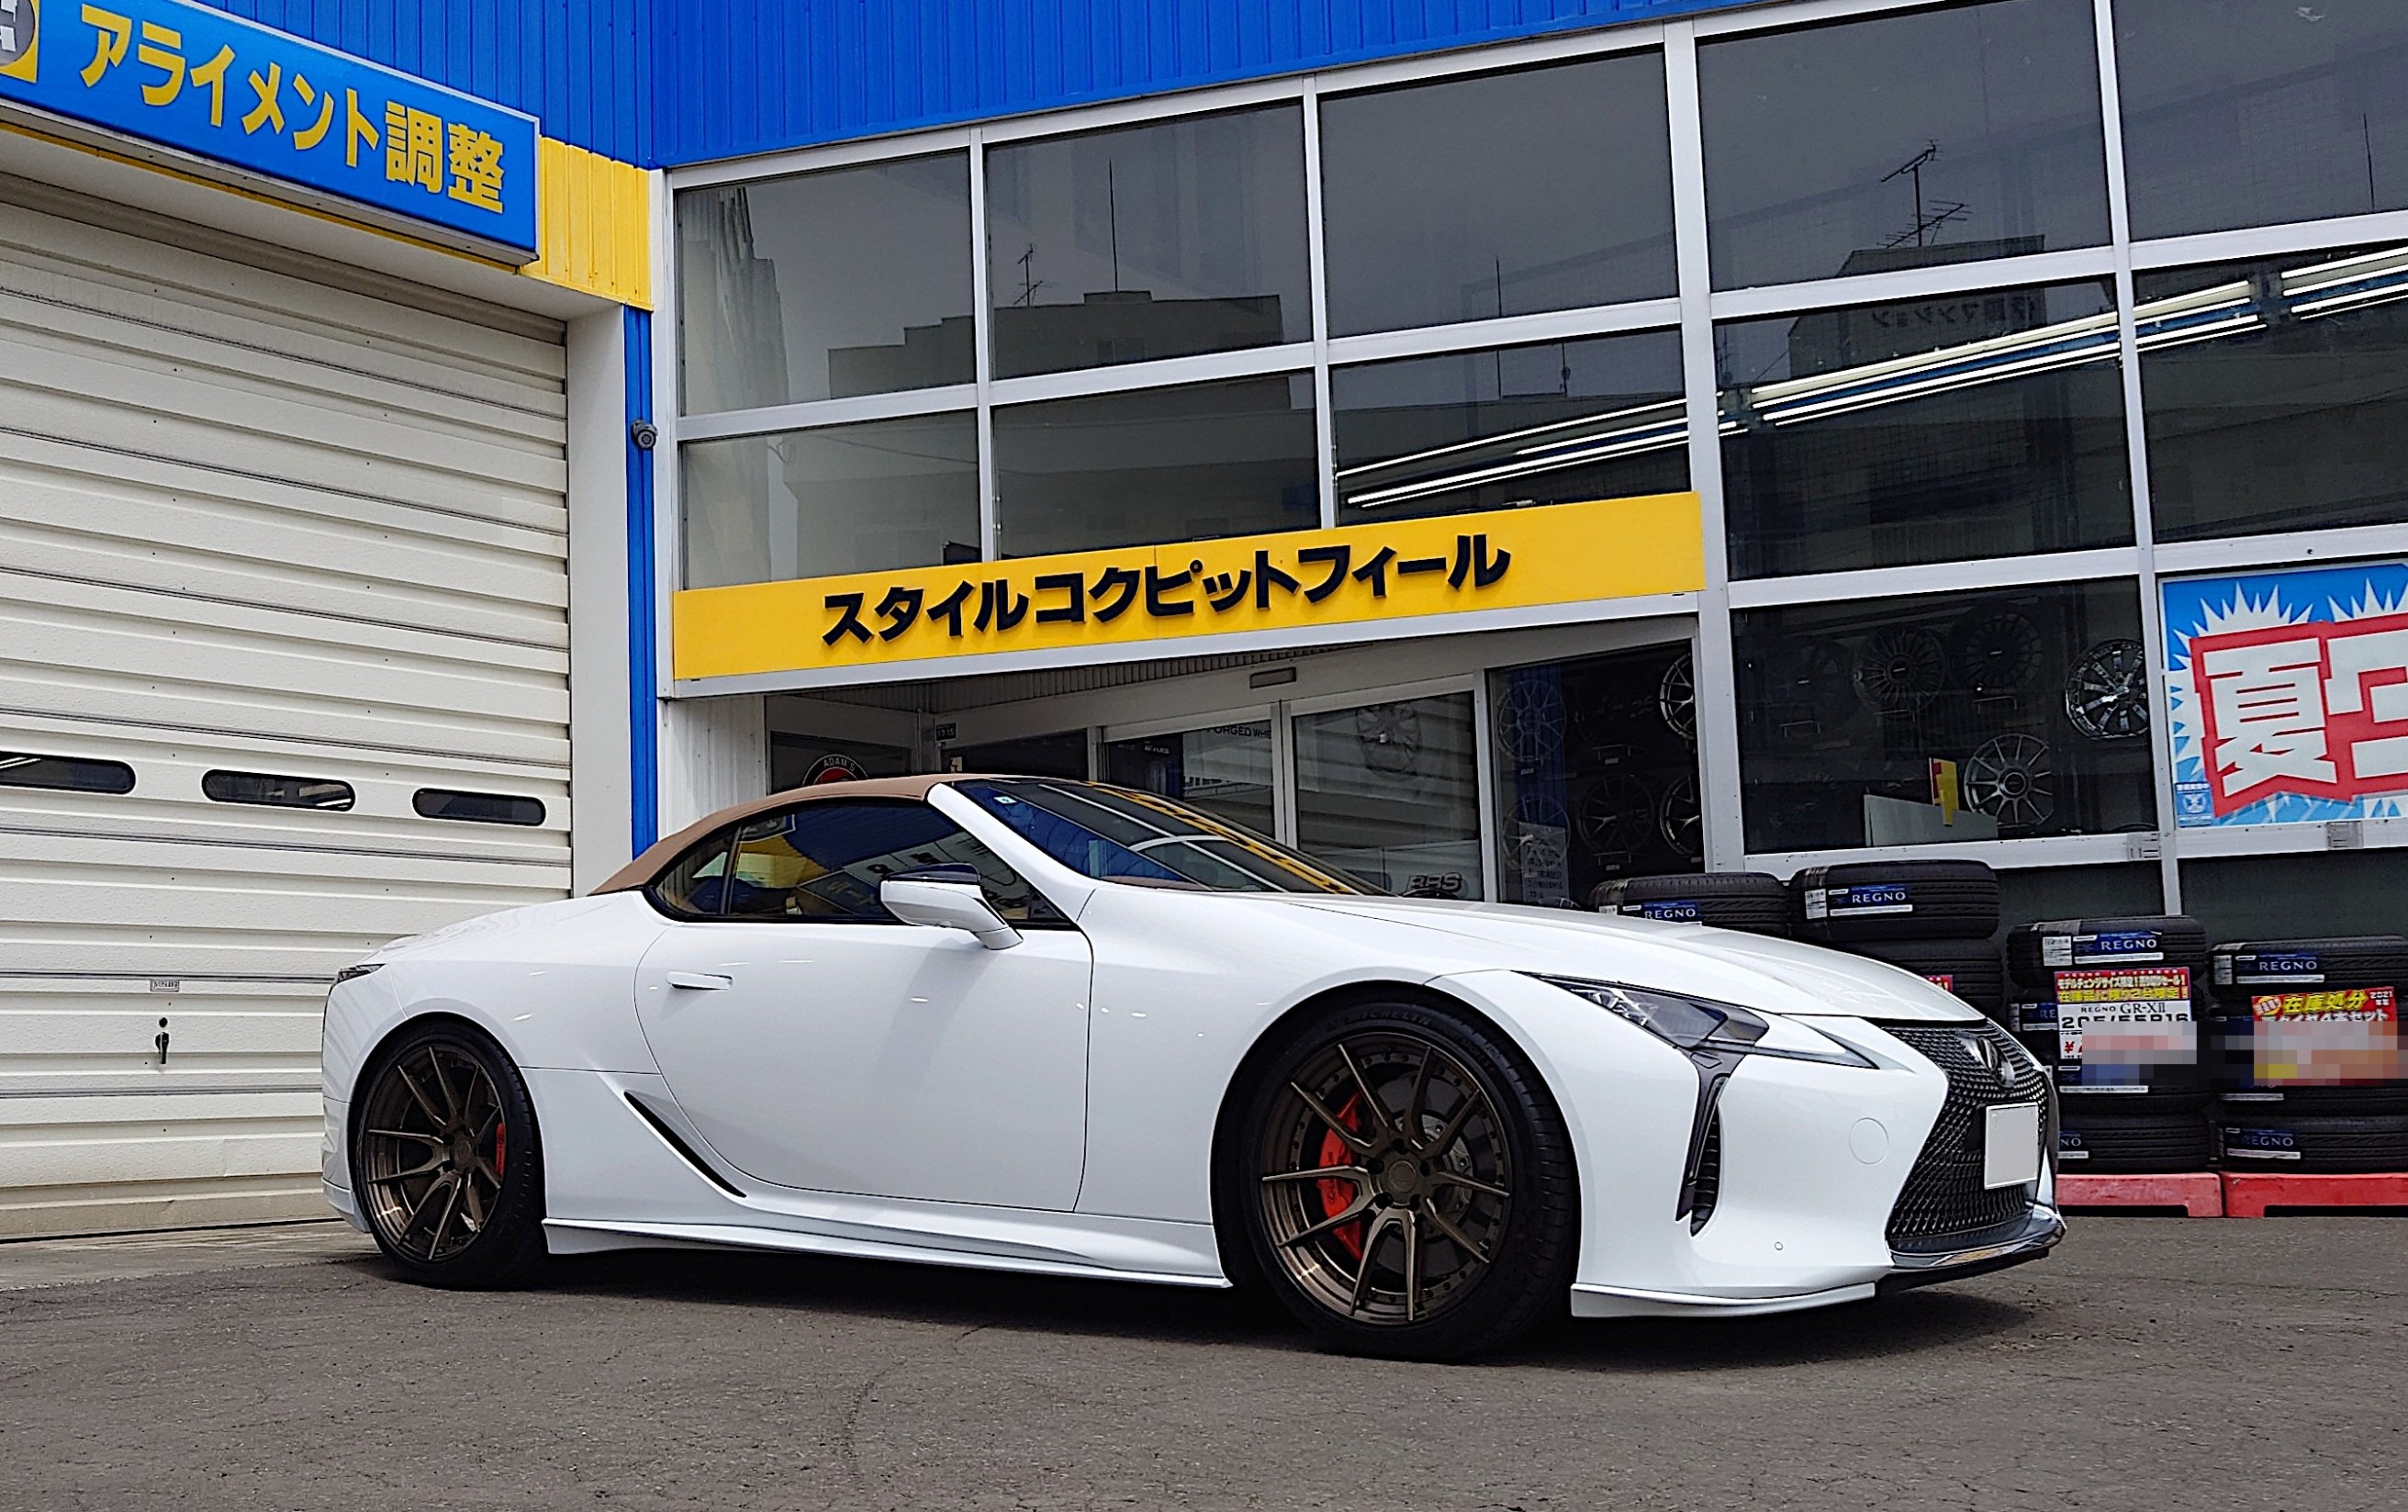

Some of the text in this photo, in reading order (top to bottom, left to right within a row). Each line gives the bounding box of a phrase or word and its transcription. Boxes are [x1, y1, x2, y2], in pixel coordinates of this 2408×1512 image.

[80, 3, 504, 214] アライメント調整
[822, 533, 1512, 646] スタイルコクピットフィール
[1206, 725, 1252, 736] ORGED
[1852, 891, 1907, 904] REGNO
[1644, 907, 1697, 920] REGNO
[2101, 938, 2157, 950] REGNO
[2259, 960, 2318, 971] REGNO
[2369, 991, 2393, 1000] 2021
[2283, 990, 2369, 1014] 在庫処分
[2081, 1005, 2116, 1014] REGNO
